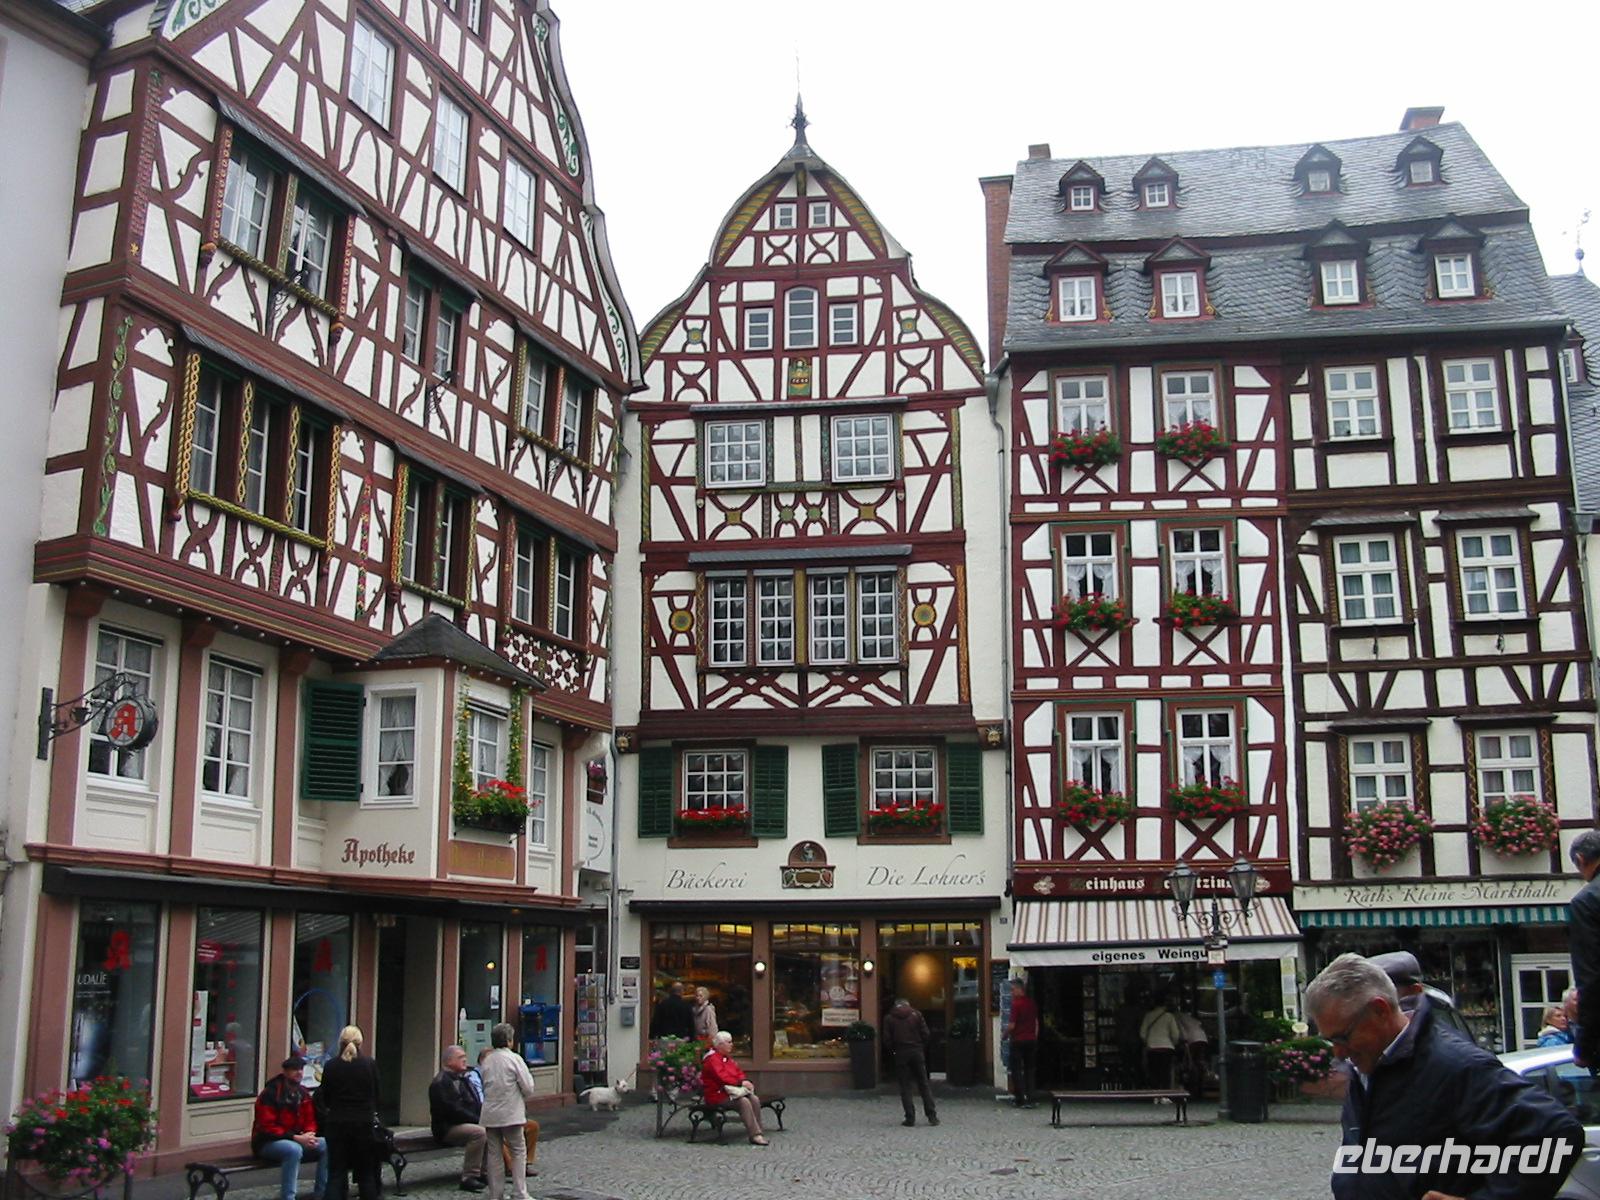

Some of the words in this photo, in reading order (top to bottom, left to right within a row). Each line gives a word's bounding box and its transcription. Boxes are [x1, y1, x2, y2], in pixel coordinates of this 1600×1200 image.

[341, 838, 415, 868] Apotheke
[666, 861, 748, 889] Bäckerei
[866, 865, 904, 887] Die
[911, 854, 986, 886] Lohner's
[1344, 884, 1394, 908] Rath's
[1402, 884, 1458, 904] Kleine
[1462, 879, 1562, 900] Markthalle
[1092, 951, 1146, 963] eigenes
[1157, 947, 1209, 960] Weingu
